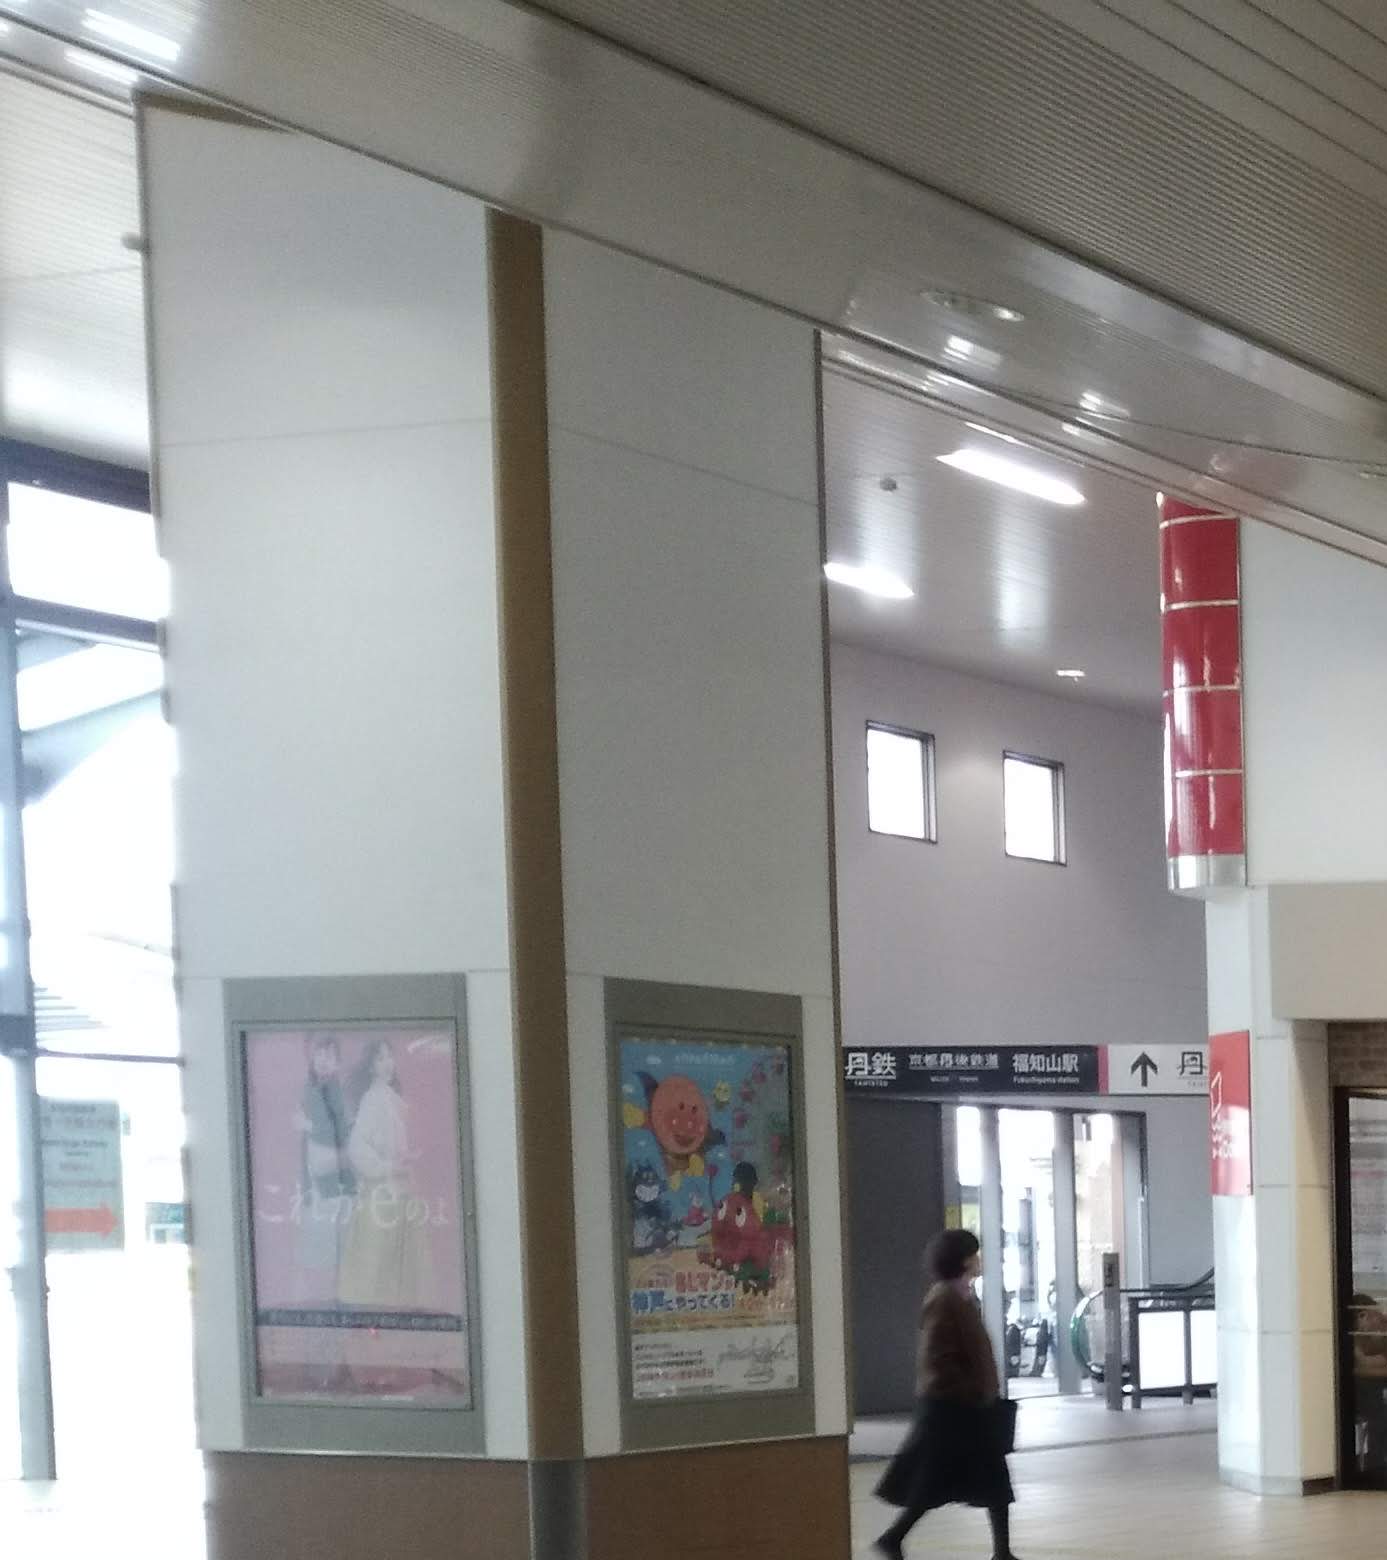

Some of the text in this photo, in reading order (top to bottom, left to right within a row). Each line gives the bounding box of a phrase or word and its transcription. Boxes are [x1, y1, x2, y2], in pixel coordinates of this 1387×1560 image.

[845, 1052, 897, 1077] 丹鉄
[1012, 1053, 1080, 1073] 福知山駅
